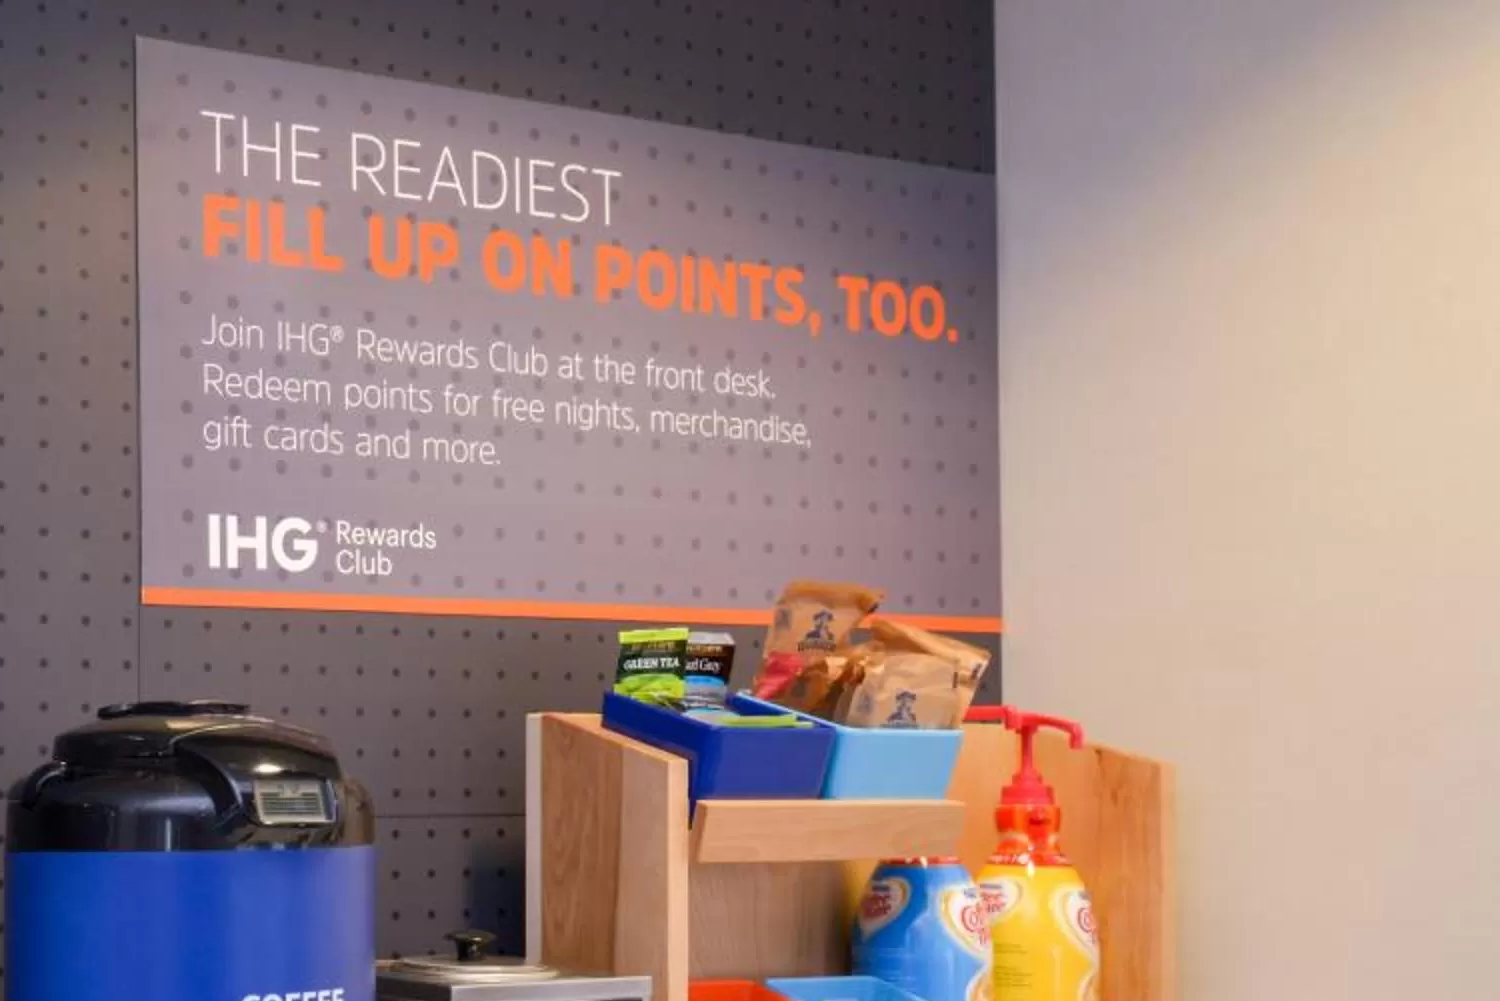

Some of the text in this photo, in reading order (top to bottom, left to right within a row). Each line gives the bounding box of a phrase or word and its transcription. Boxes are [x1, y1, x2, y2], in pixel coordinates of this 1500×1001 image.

[200, 110, 622, 226] THE READIEST
[203, 192, 959, 344] FILL UP ON POINTS, TOO.
[201, 313, 264, 350] Join
[357, 327, 480, 369] Rewards
[489, 340, 548, 377] Club
[557, 352, 585, 381] at
[593, 353, 637, 385] the
[644, 357, 706, 393] front
[713, 365, 776, 399] desk.
[203, 363, 812, 448] Redeem points for free nights, merchandise,
[202, 416, 501, 465] gift cards and more.
[336, 519, 437, 549] Rewards
[336, 549, 393, 575] Club
[623, 657, 680, 670] GREEN TEA
